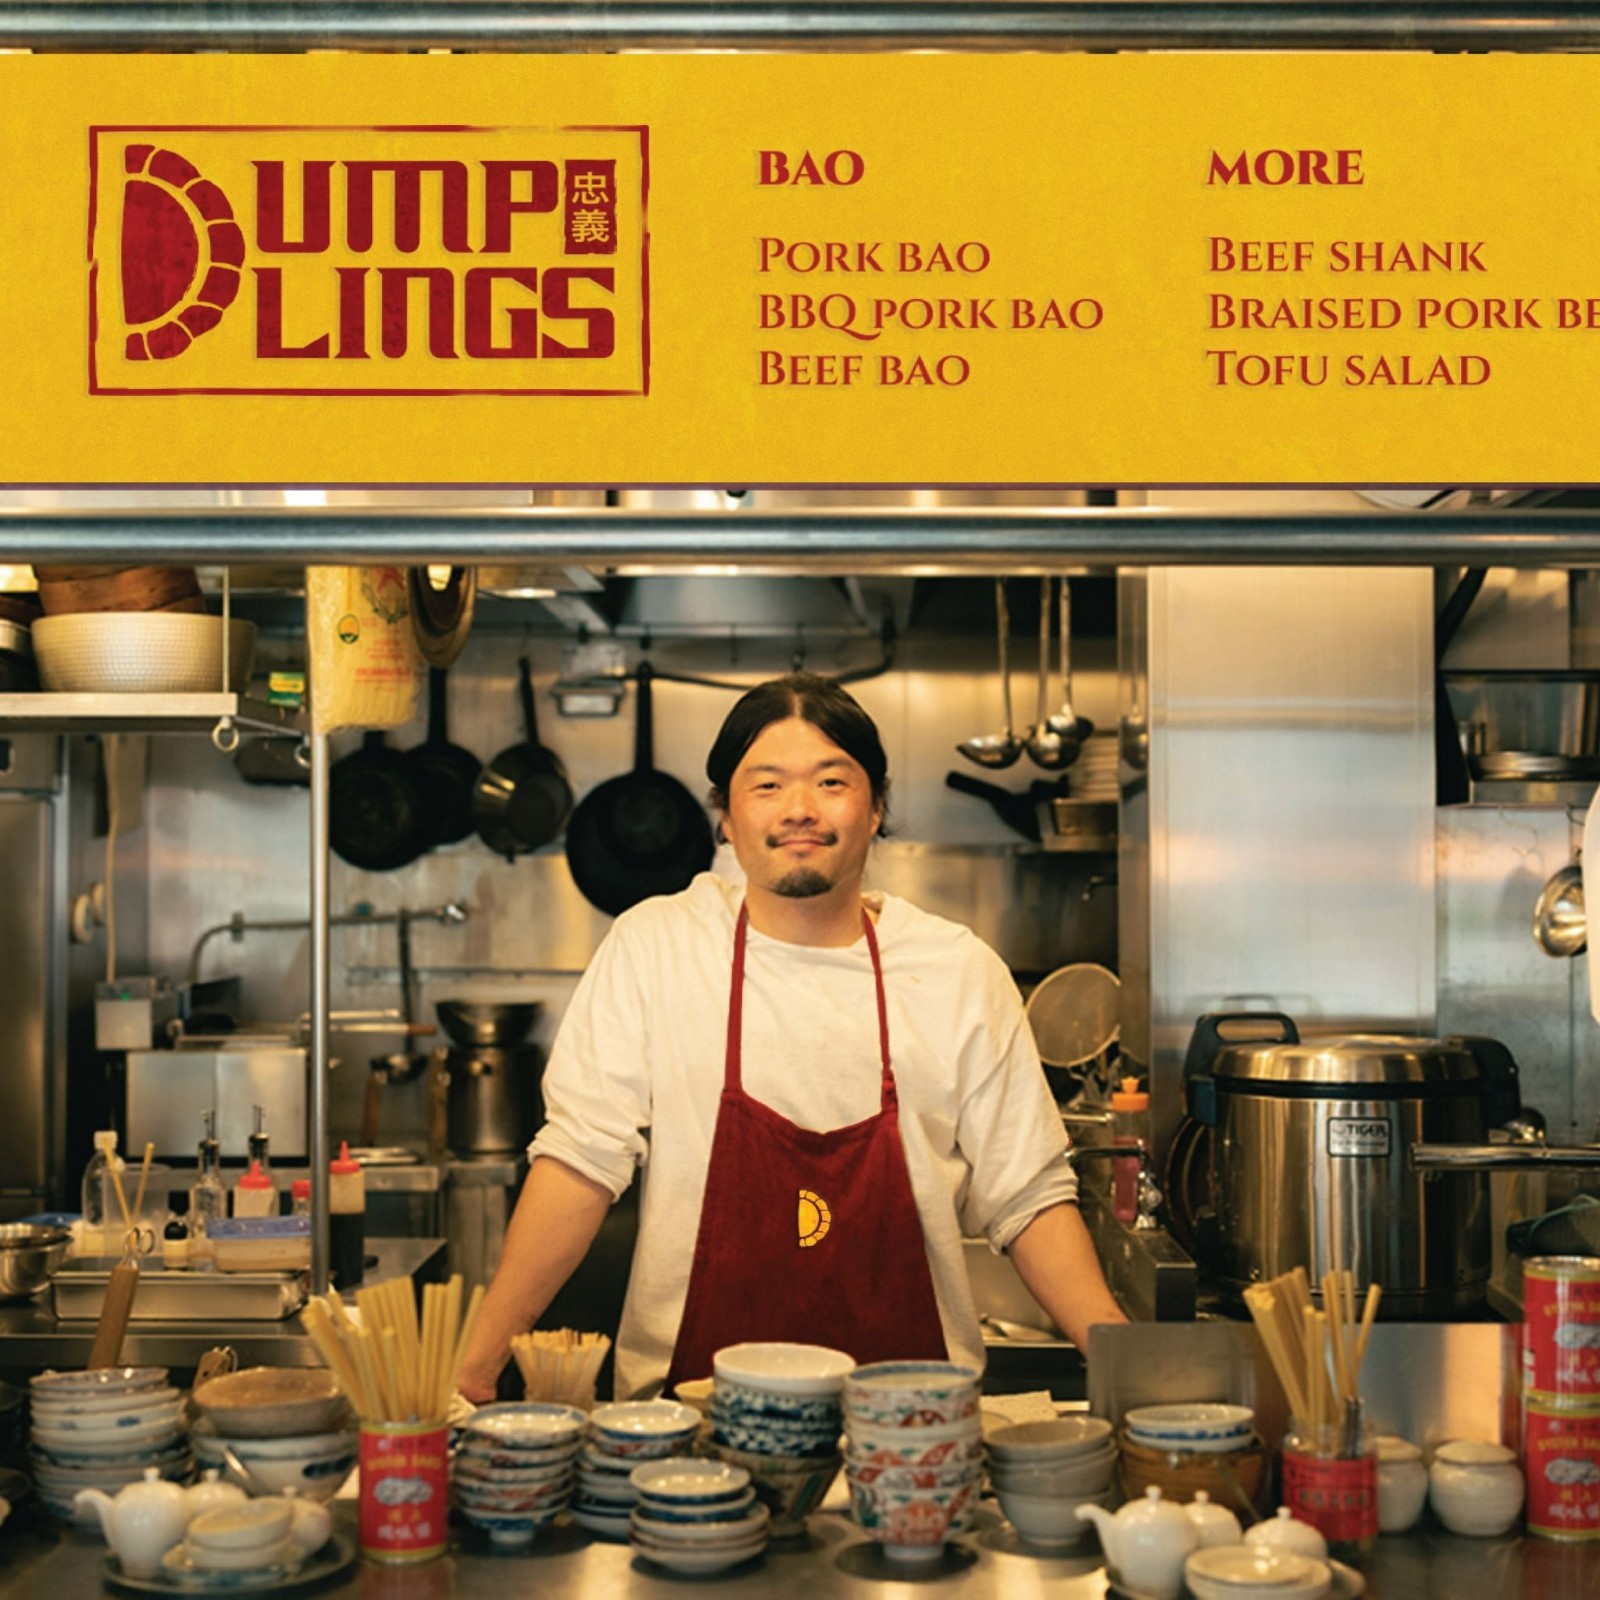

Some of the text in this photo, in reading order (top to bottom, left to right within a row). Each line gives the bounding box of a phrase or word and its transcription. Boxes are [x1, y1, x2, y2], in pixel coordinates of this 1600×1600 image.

[759, 150, 865, 186] BAO
[1207, 149, 1364, 186] MORE
[571, 171, 610, 243] 忠義
[760, 237, 991, 273] PORK BAO
[1210, 236, 1487, 273] BEEF SHANK
[760, 293, 1104, 341] BBQ PORK BAO
[1210, 293, 1402, 329] BRAISED
[1418, 298, 1542, 329] PORK
[760, 350, 970, 386] BEEF BAO
[1206, 350, 1491, 386] TOFU SALAD
[1347, 1123, 1387, 1136] TIGER
